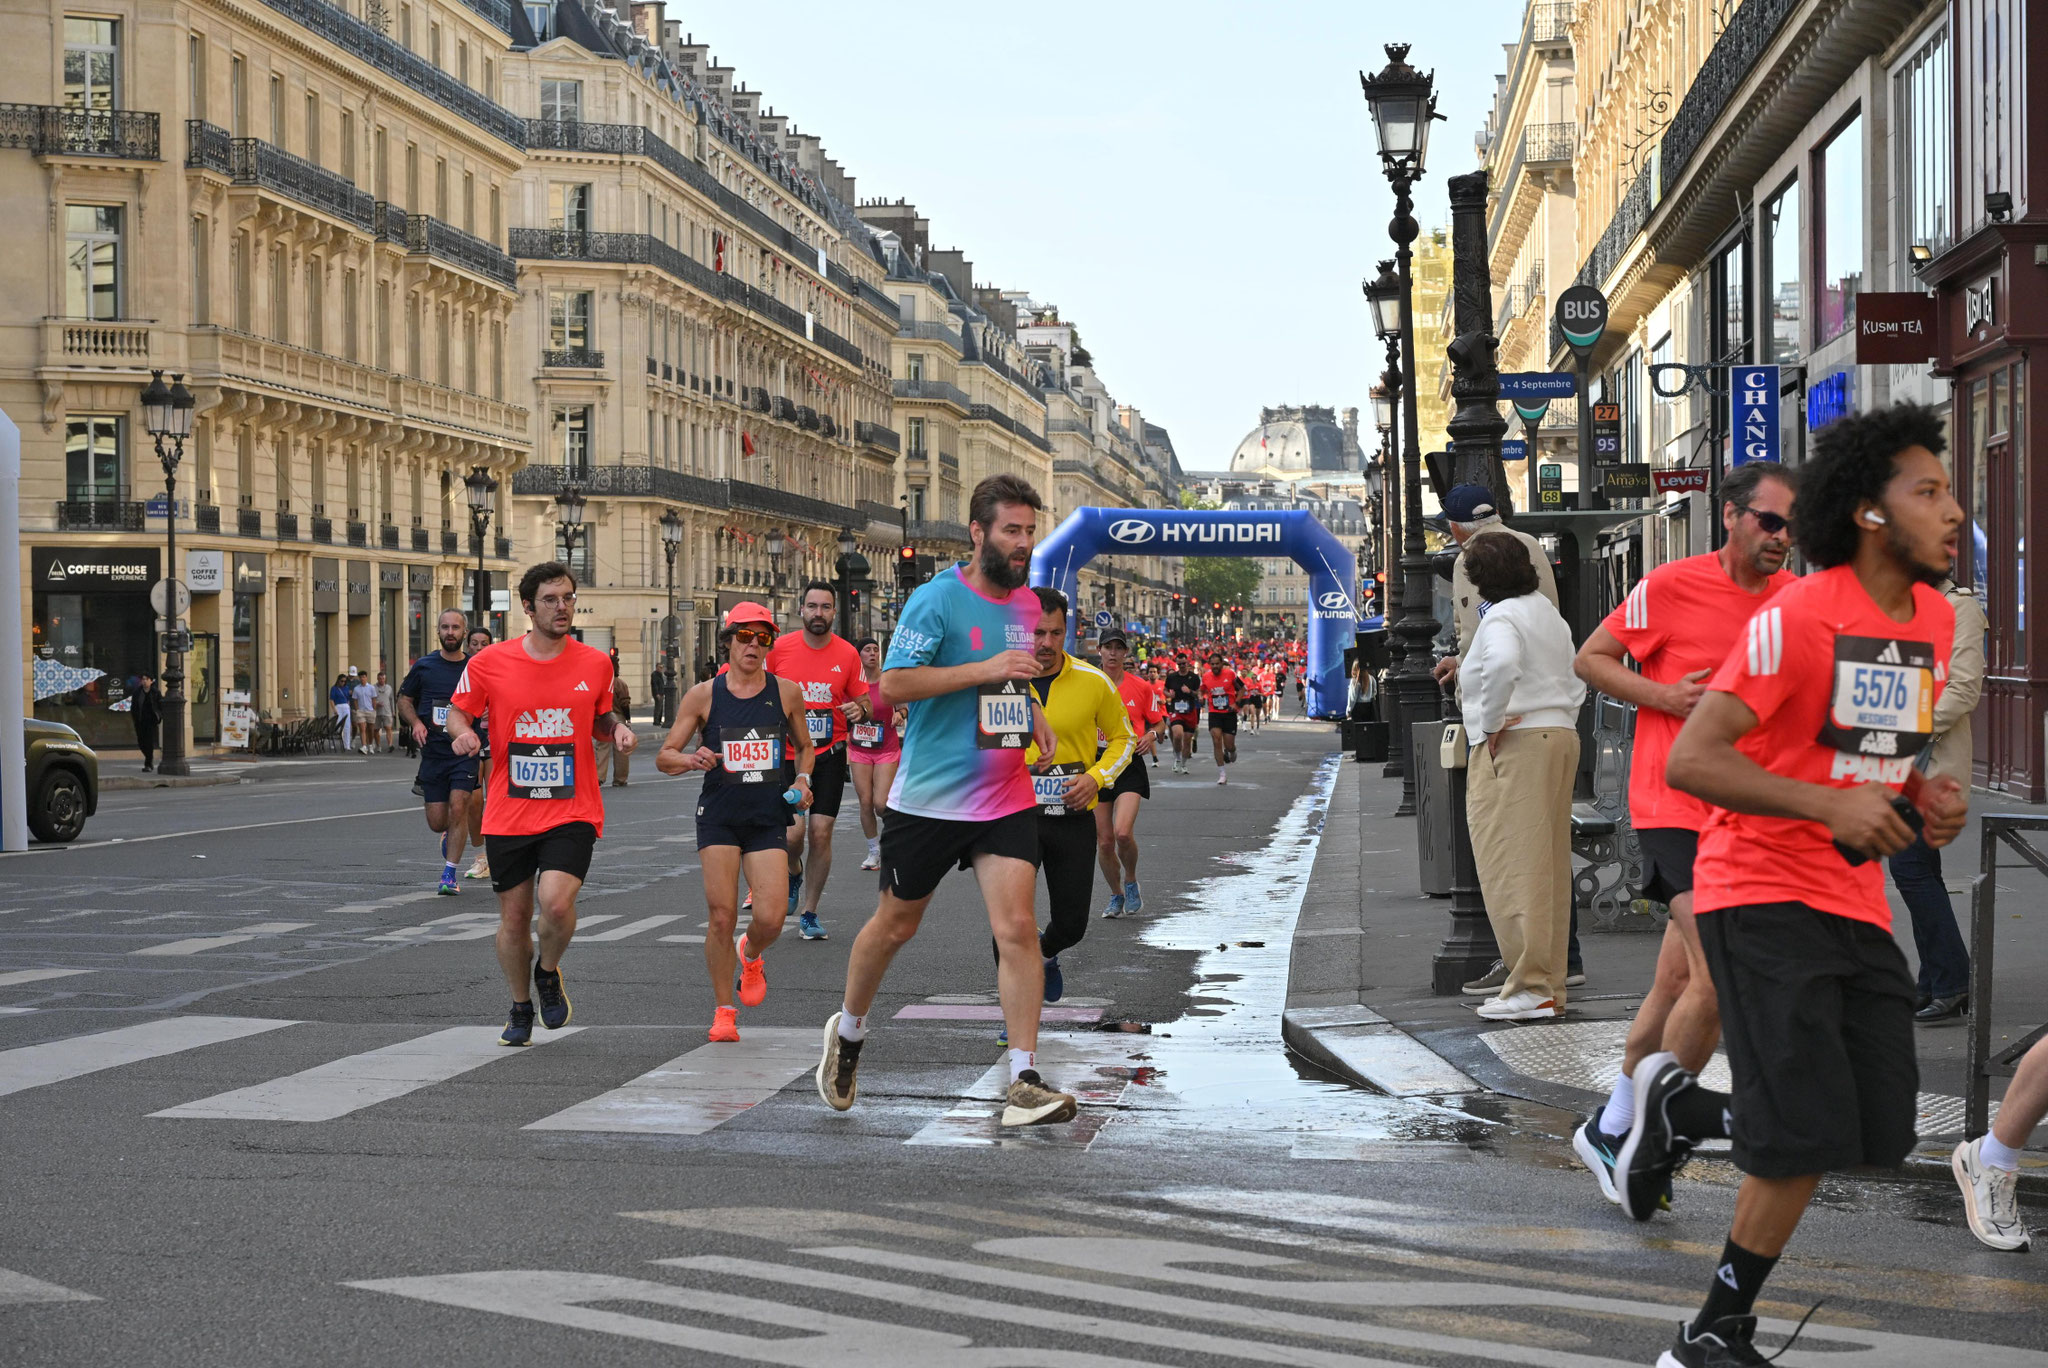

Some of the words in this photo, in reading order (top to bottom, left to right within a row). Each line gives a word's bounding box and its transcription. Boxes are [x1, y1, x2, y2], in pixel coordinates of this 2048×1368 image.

[1564, 300, 1600, 319] BUS
[1863, 320, 1898, 335] KUSMI
[1901, 319, 1923, 335] TEA
[1521, 380, 1571, 391] Septembre
[1598, 407, 1616, 419] 27
[1743, 372, 1768, 462] CHANG
[1501, 445, 1523, 454] embre
[1598, 438, 1616, 452] 95
[1544, 467, 1556, 476] 21
[1606, 473, 1648, 486] Amaya
[1544, 492, 1558, 502] 68
[1162, 523, 1281, 543] HYUNDAI
[68, 565, 110, 575] COFFEE
[111, 565, 147, 575] HOUSE
[1313, 611, 1353, 619] HYUNDAI
[1852, 668, 1908, 710] 5576
[535, 708, 574, 727] 10K
[987, 702, 1024, 726] 16146
[515, 722, 574, 738] PARIS
[856, 725, 876, 737] 18900
[727, 742, 769, 762] 18433
[516, 761, 558, 782] 16735
